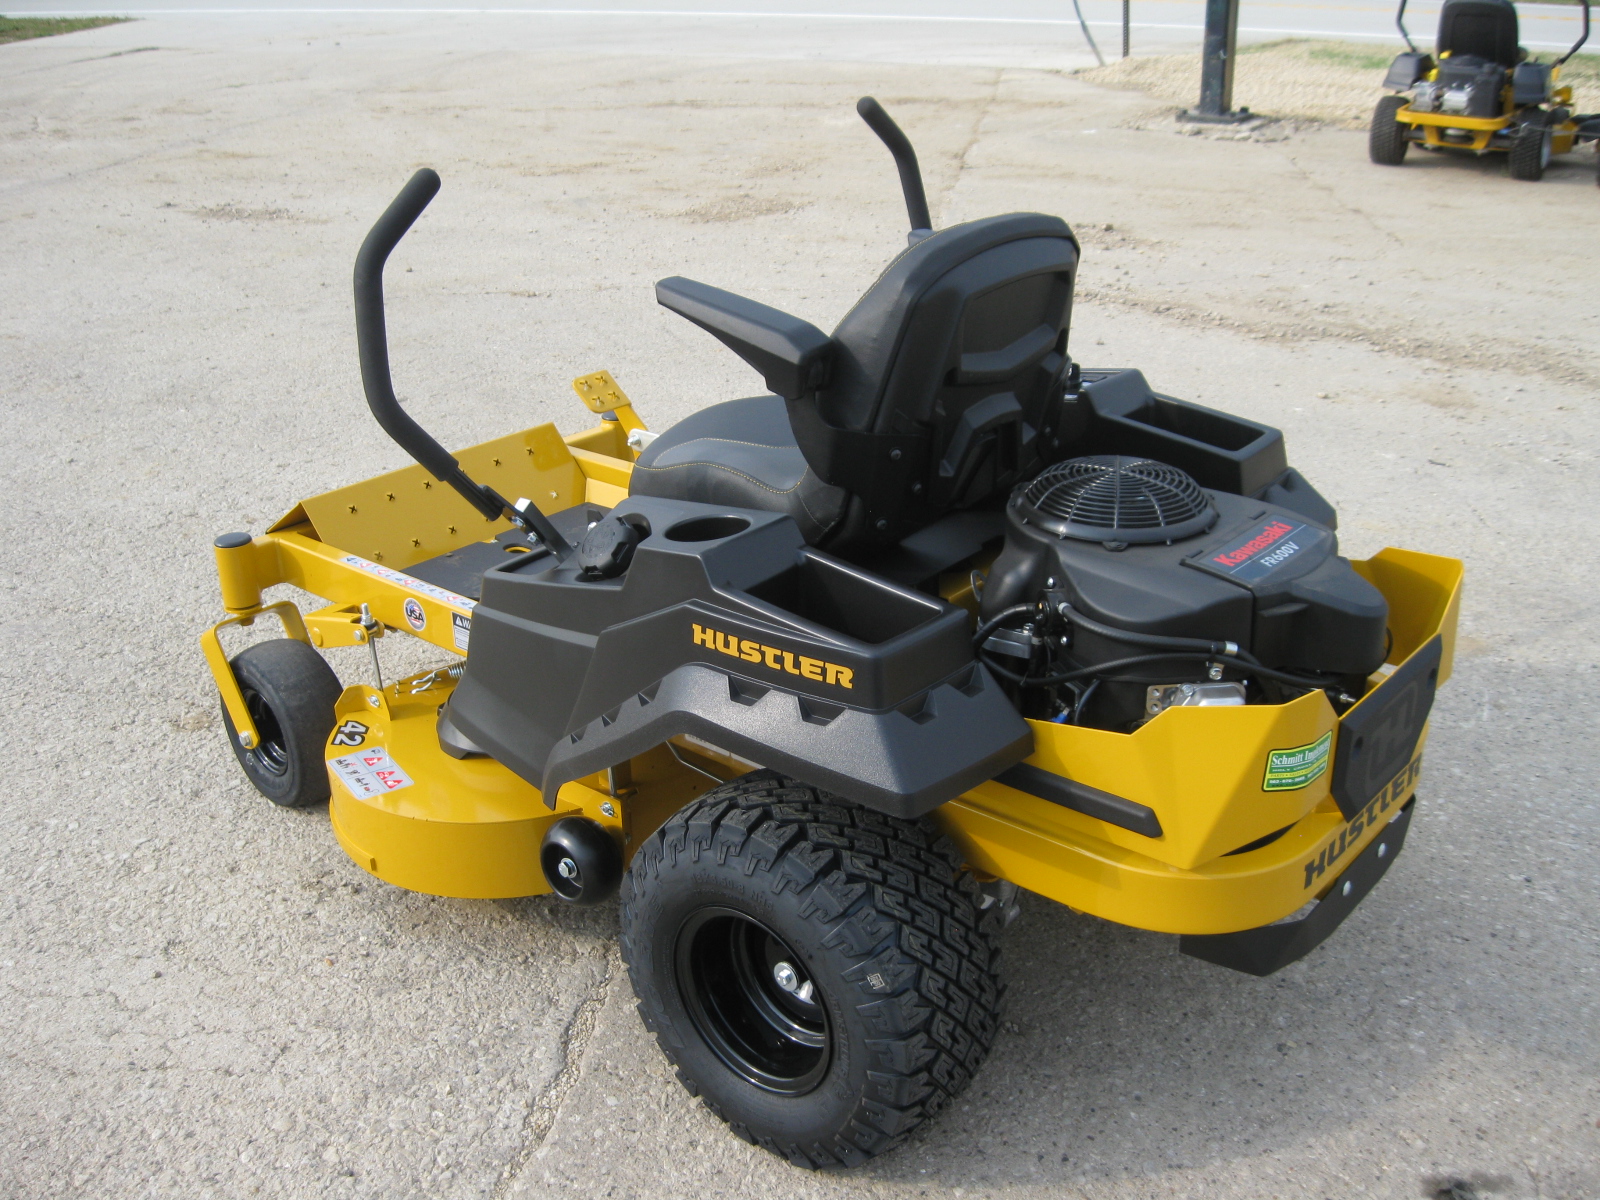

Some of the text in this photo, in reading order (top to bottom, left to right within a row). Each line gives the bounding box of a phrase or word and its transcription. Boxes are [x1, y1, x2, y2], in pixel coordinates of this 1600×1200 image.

[1213, 521, 1293, 567] Kawasaki
[1260, 541, 1300, 567] FR600V
[405, 606, 425, 623] USA
[692, 623, 854, 689] HUSTLER
[332, 720, 368, 746] 42
[1271, 754, 1304, 765] Schmitt
[1304, 753, 1422, 889] HUSTLER
